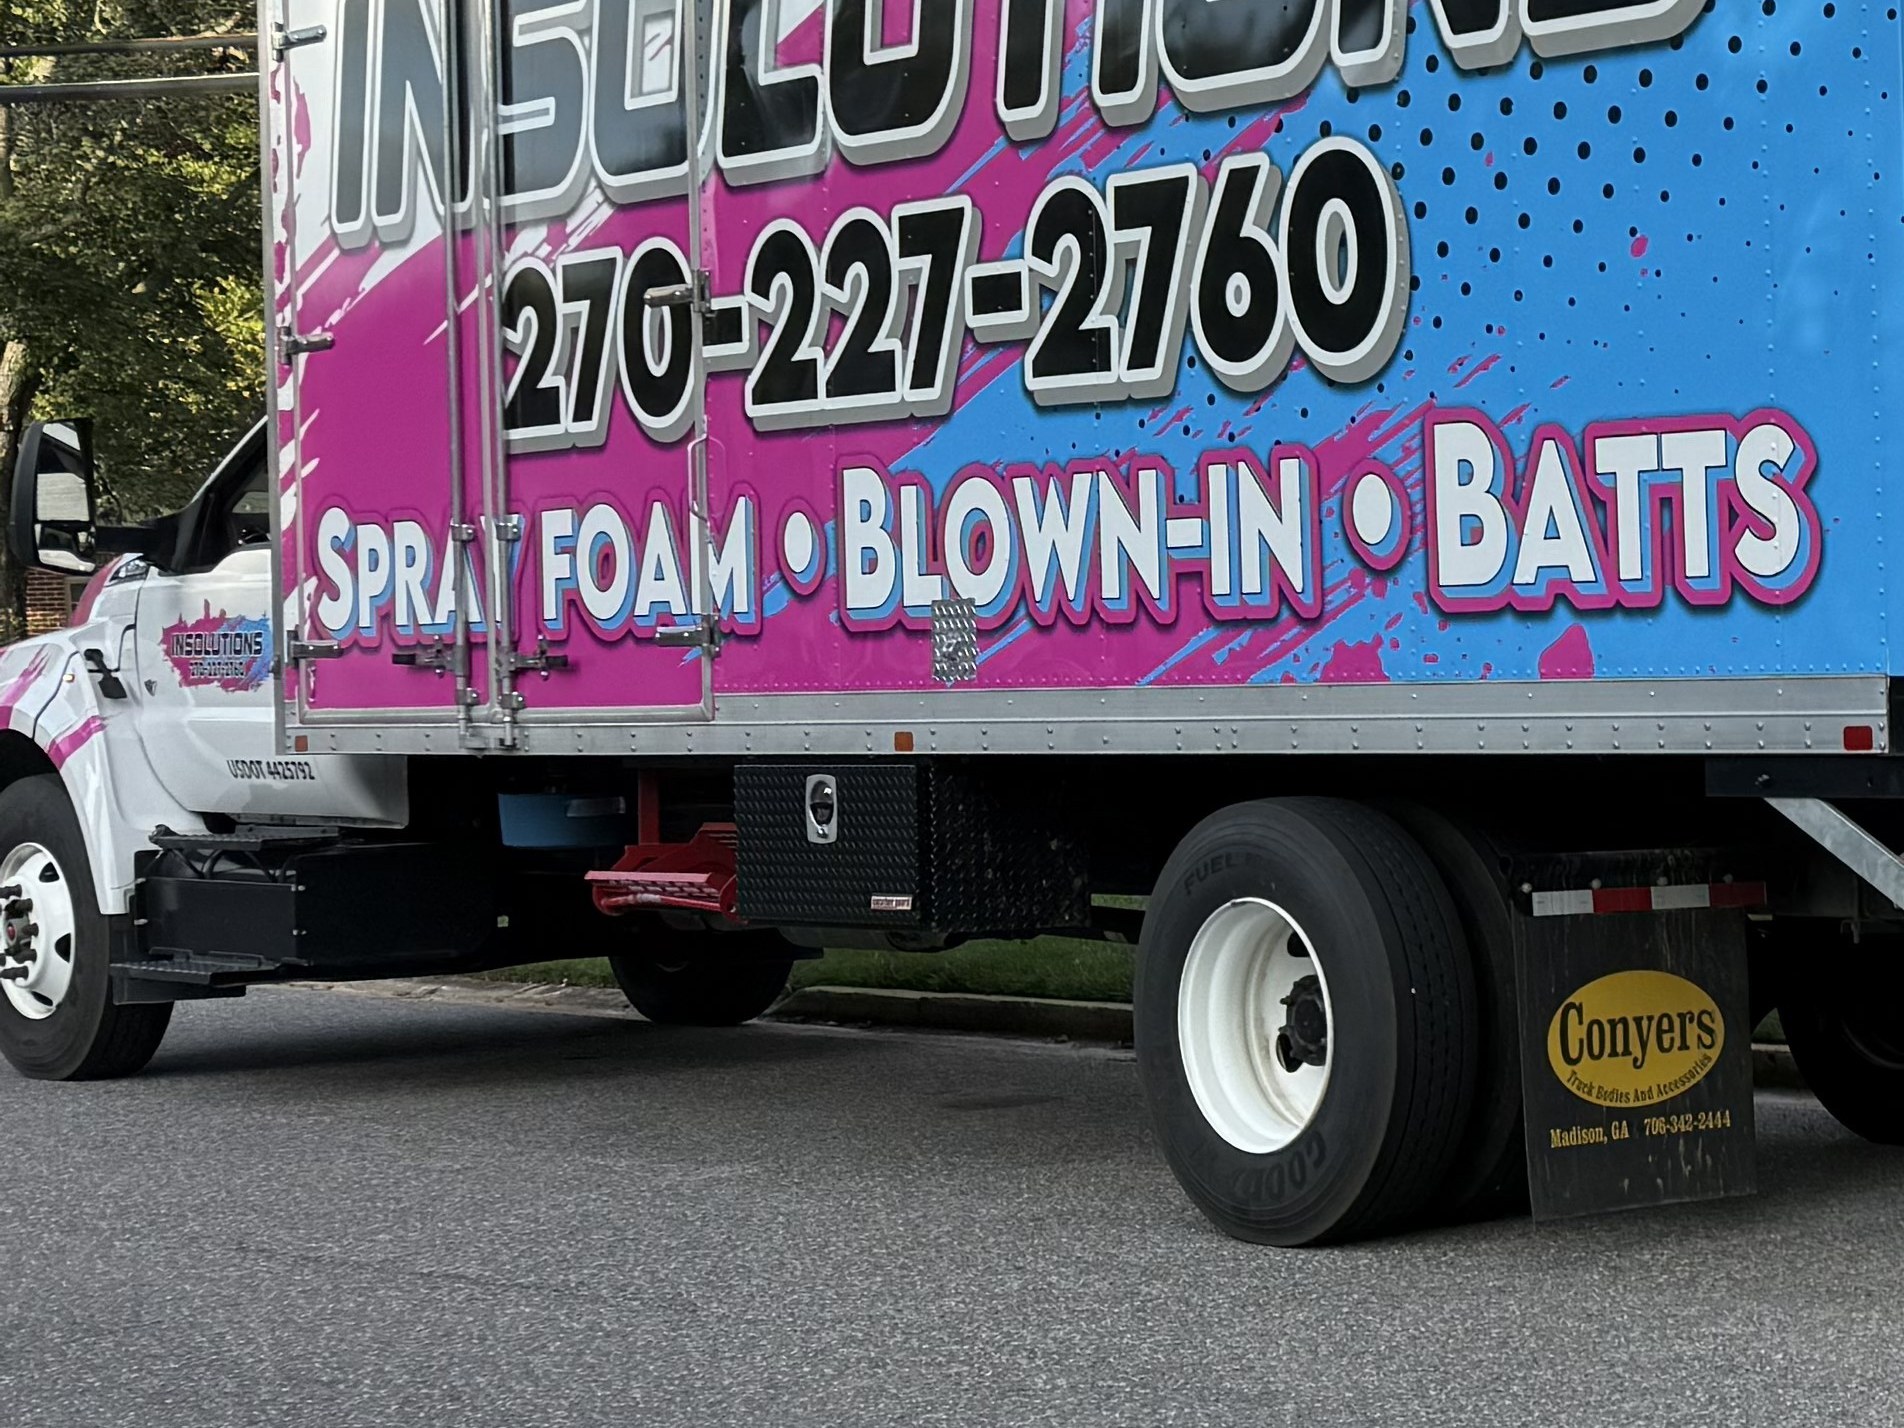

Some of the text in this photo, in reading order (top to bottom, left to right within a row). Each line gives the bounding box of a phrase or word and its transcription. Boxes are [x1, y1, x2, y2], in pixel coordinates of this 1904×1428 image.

[500, 134, 1409, 454] 270-227-2760
[540, 495, 753, 622] FOAM
[843, 457, 1312, 620] BLOWN-IN
[1431, 420, 1805, 594] BATTS
[171, 632, 263, 656] INSOLUTIONS
[226, 759, 267, 780] USDOT
[1184, 852, 1238, 895] FUEL
[1559, 1001, 1717, 1070] Conyers
[1566, 1053, 1713, 1105] Truck Bodies And Accessories
[1550, 1109, 1732, 1149] Madison, GA 706-342-2444
